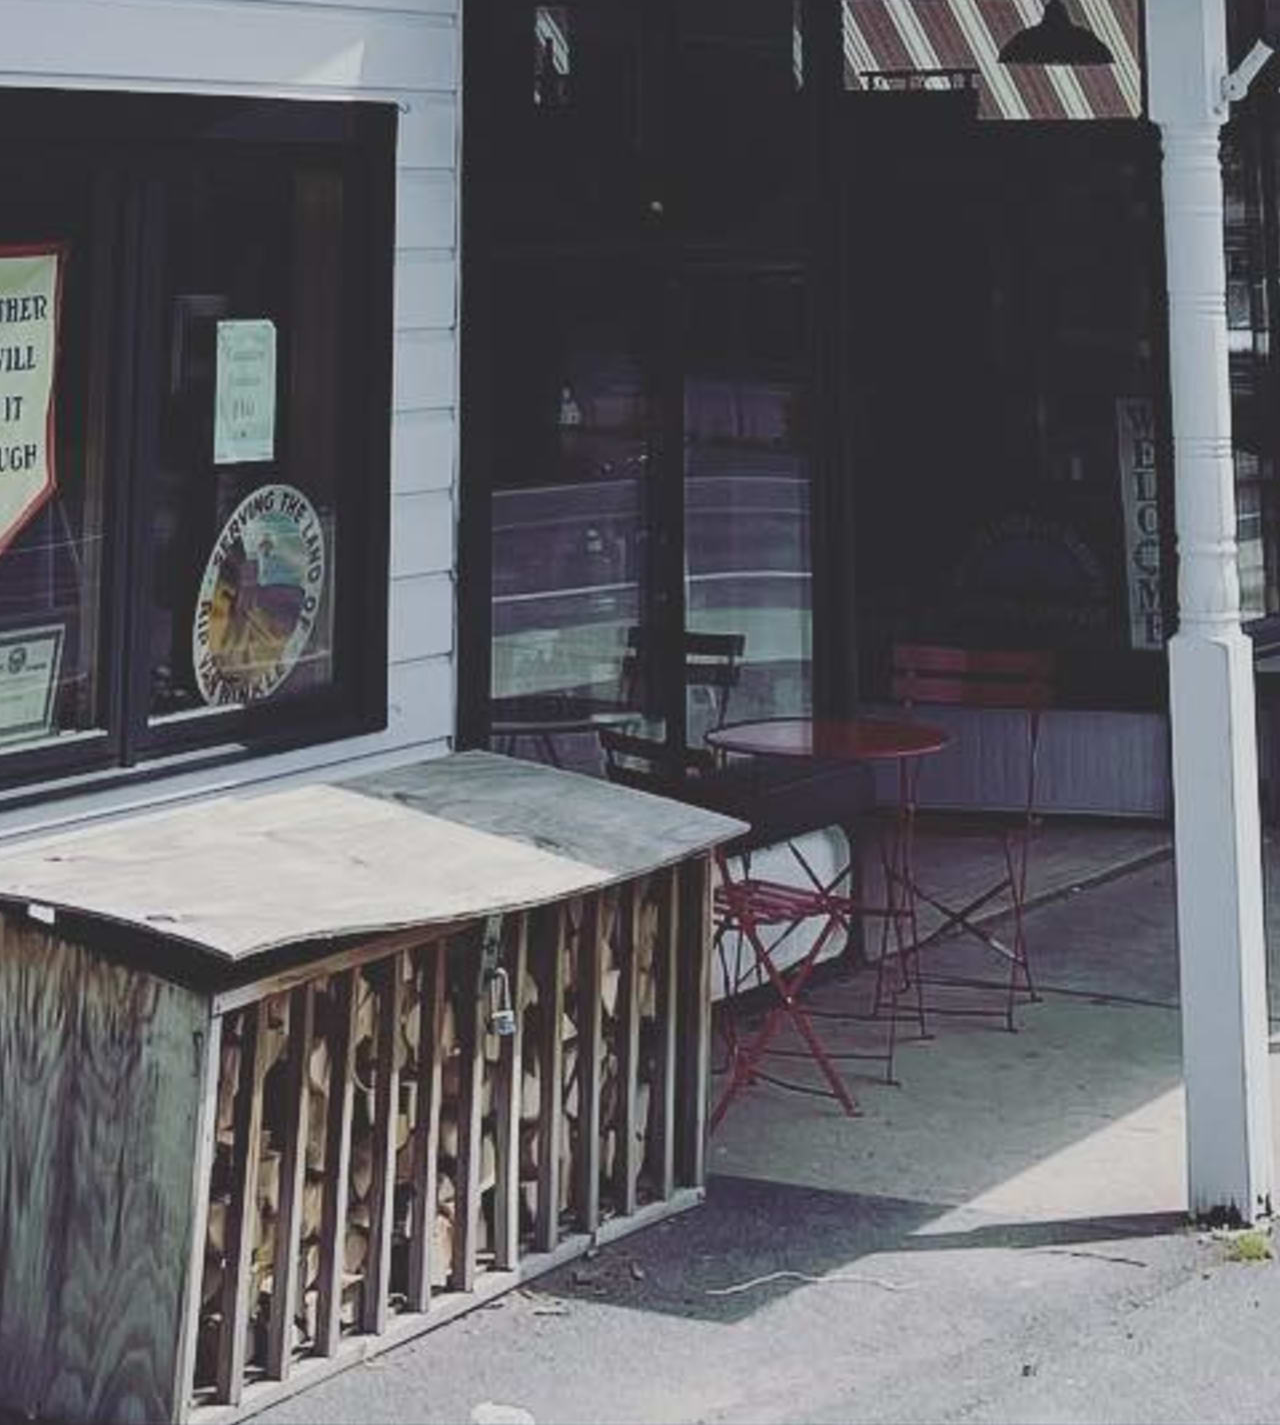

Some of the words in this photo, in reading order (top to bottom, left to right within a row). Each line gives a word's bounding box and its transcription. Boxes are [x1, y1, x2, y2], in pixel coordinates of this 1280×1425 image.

[4, 396, 24, 423] IT
[212, 491, 277, 567] SERVING
[280, 493, 307, 524] THE
[300, 521, 322, 583] LAND
[1124, 403, 1163, 649] WELCOME
